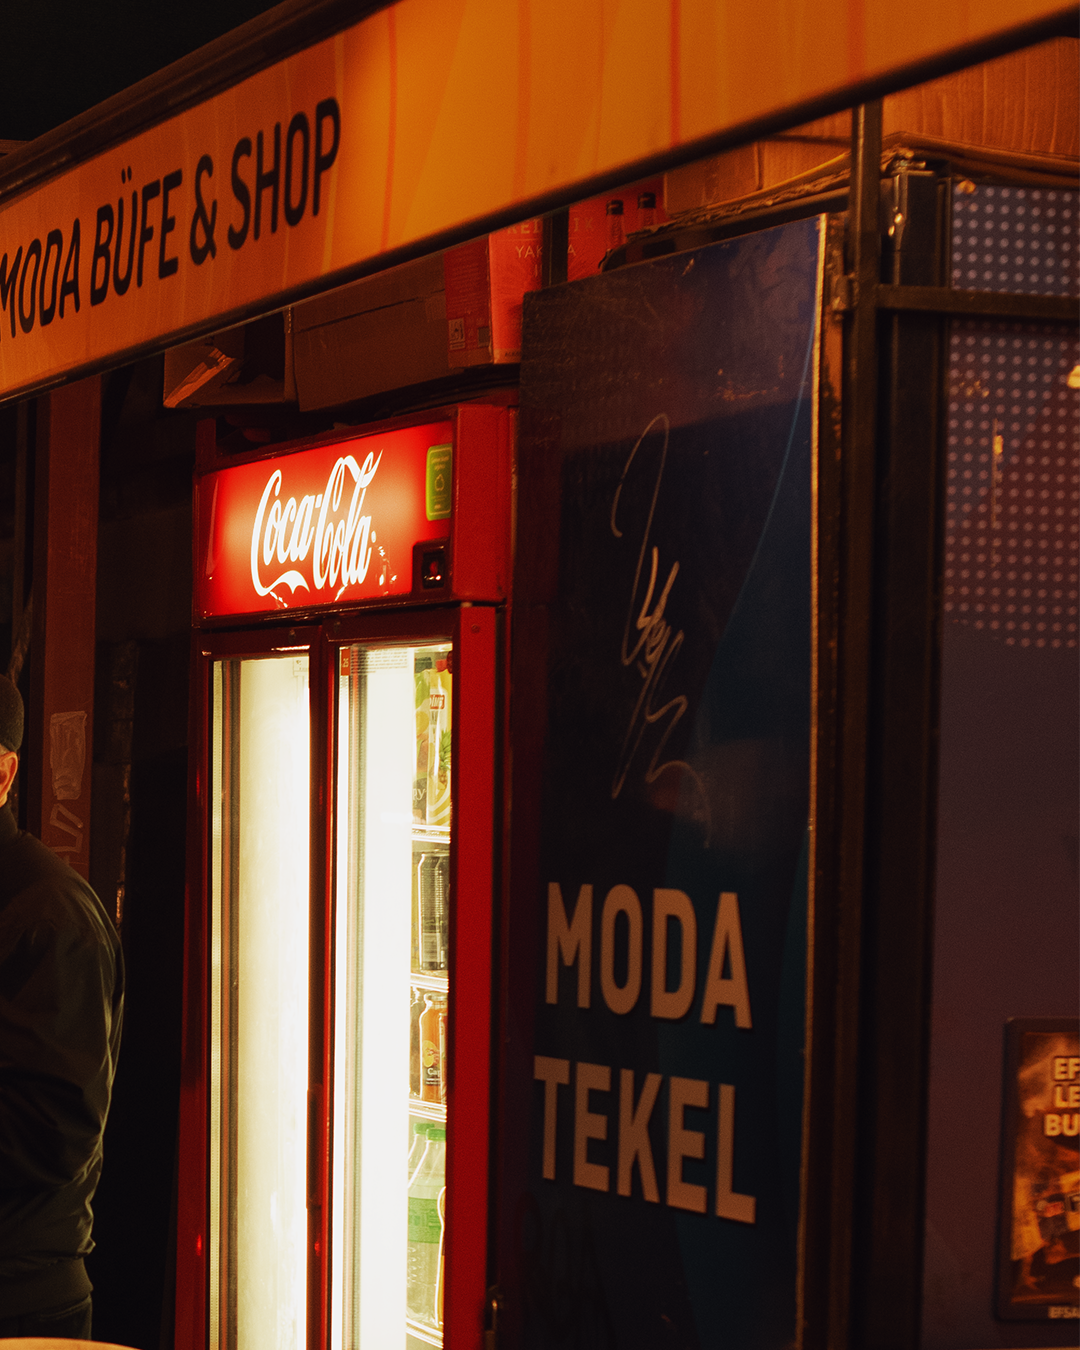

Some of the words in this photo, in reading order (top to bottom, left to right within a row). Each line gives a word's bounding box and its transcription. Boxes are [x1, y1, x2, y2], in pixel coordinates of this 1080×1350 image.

[90, 165, 183, 308] BÜFE
[188, 154, 218, 267] &
[227, 97, 341, 251] SHOP
[250, 449, 384, 597] Coca-Cola
[544, 881, 754, 1030] MODA
[533, 1054, 758, 1226] TEKEL
